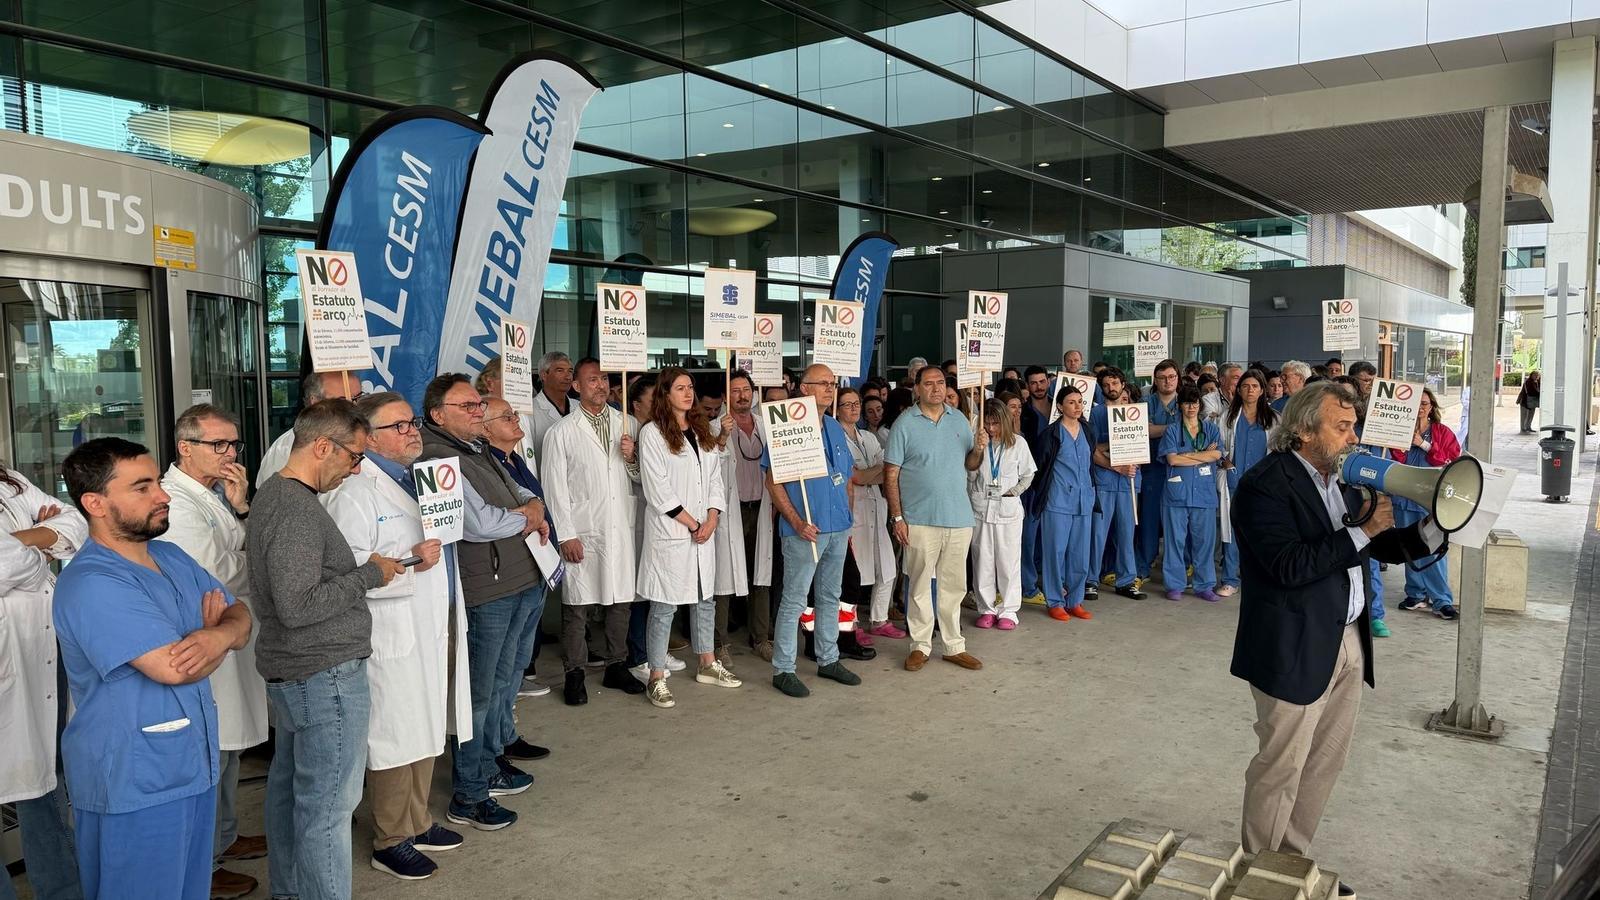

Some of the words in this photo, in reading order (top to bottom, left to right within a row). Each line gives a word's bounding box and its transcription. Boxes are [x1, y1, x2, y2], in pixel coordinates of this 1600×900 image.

[522, 78, 561, 170] CESM
[0, 173, 145, 235] DULTS
[384, 150, 432, 280] CESM
[463, 171, 540, 381] IMEBAL
[855, 256, 874, 310] ESM
[312, 294, 356, 307] Estatuto
[604, 316, 640, 326] Estatuto
[972, 319, 1001, 329] Estatuto
[820, 328, 856, 339] Estatuto
[754, 340, 776, 348] atuto
[506, 353, 528, 366] Estatuto
[1374, 401, 1412, 414] Estatuto
[771, 425, 814, 439] Estatuto
[1113, 425, 1144, 433] Estatuto
[420, 498, 463, 516] Estatuto
